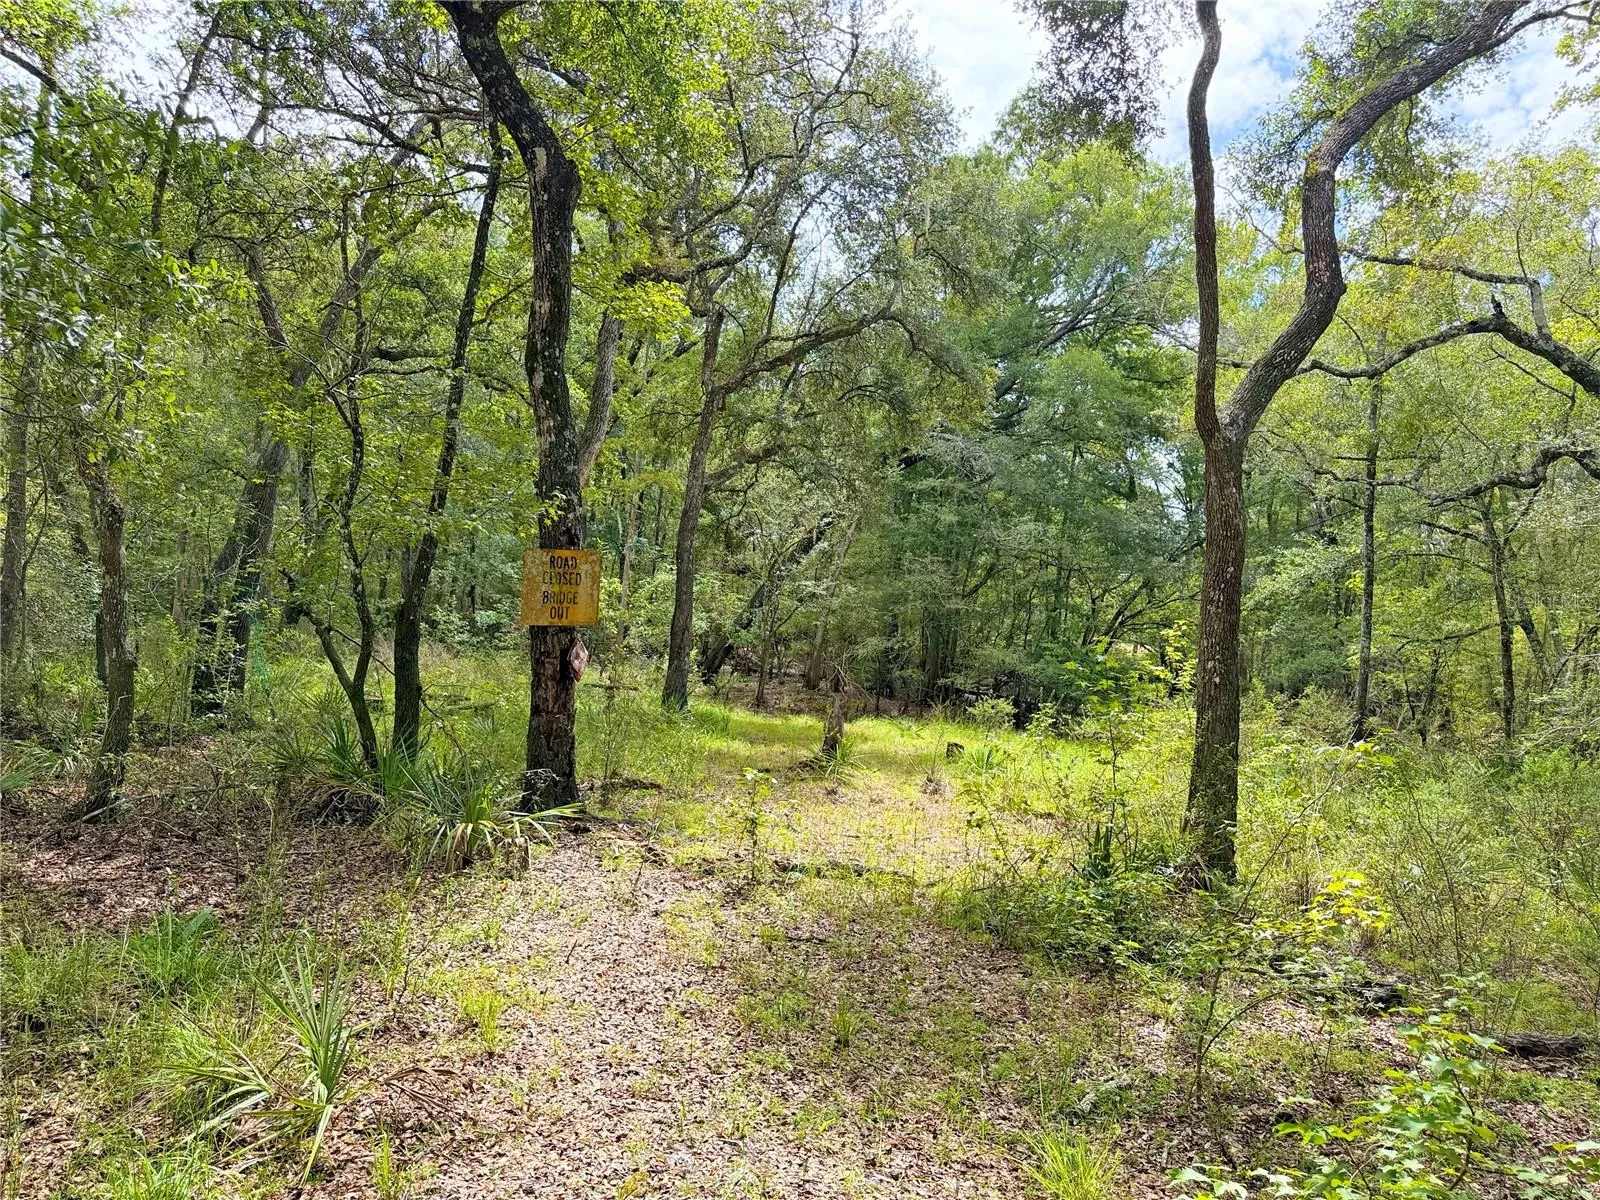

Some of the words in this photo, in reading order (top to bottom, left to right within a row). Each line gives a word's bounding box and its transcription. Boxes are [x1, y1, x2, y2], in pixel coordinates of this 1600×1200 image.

[549, 555, 578, 570] ROAD
[542, 571, 582, 586] CLOSED
[542, 590, 579, 605] BRIDGE
[549, 606, 571, 620] OUT
